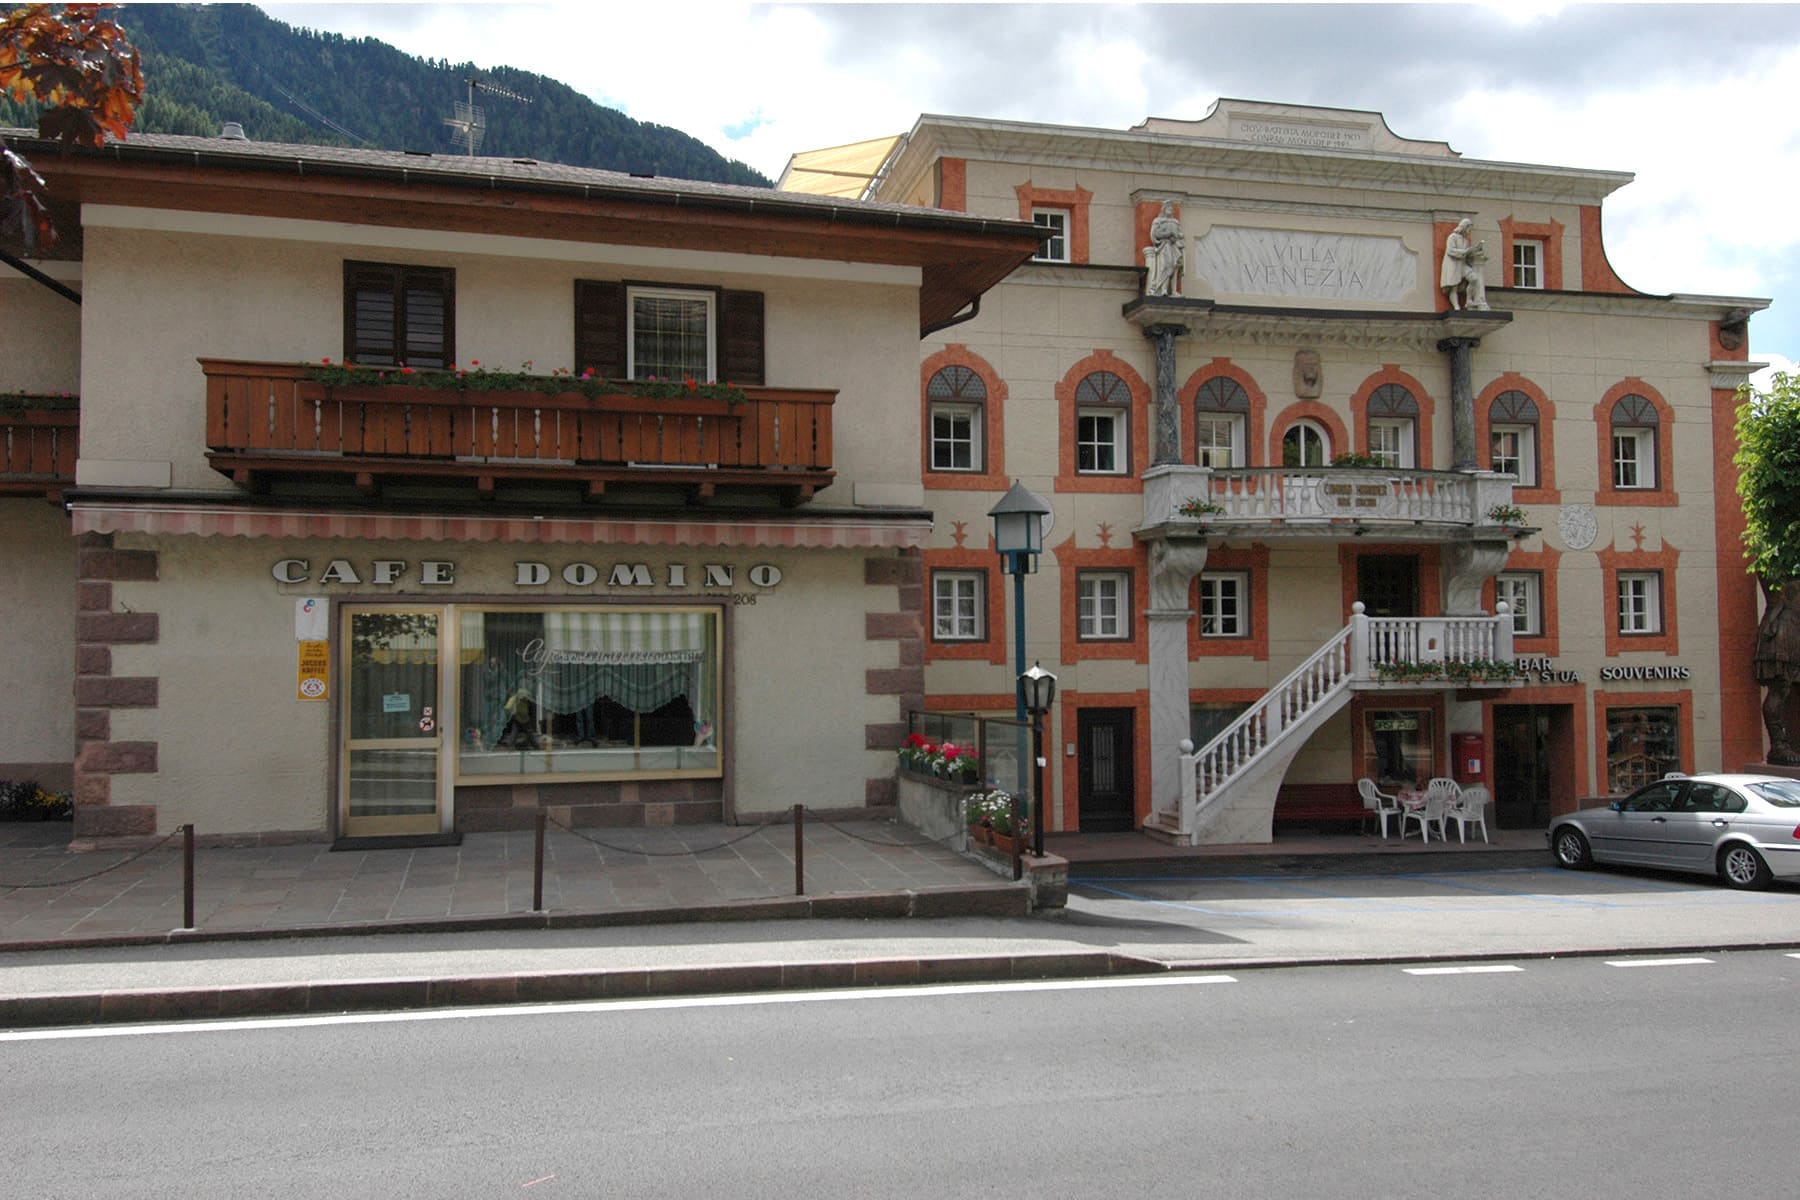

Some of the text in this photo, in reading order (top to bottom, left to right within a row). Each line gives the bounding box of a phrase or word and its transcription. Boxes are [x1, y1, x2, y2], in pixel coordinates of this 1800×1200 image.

[1273, 244, 1336, 263] VILLA
[1244, 264, 1364, 289] VENEZIA
[271, 559, 783, 588] CAFE DOMINO
[1519, 658, 1553, 671] BAR
[1601, 665, 1692, 681] SOUVENIRS
[1541, 671, 1581, 683] STUA
